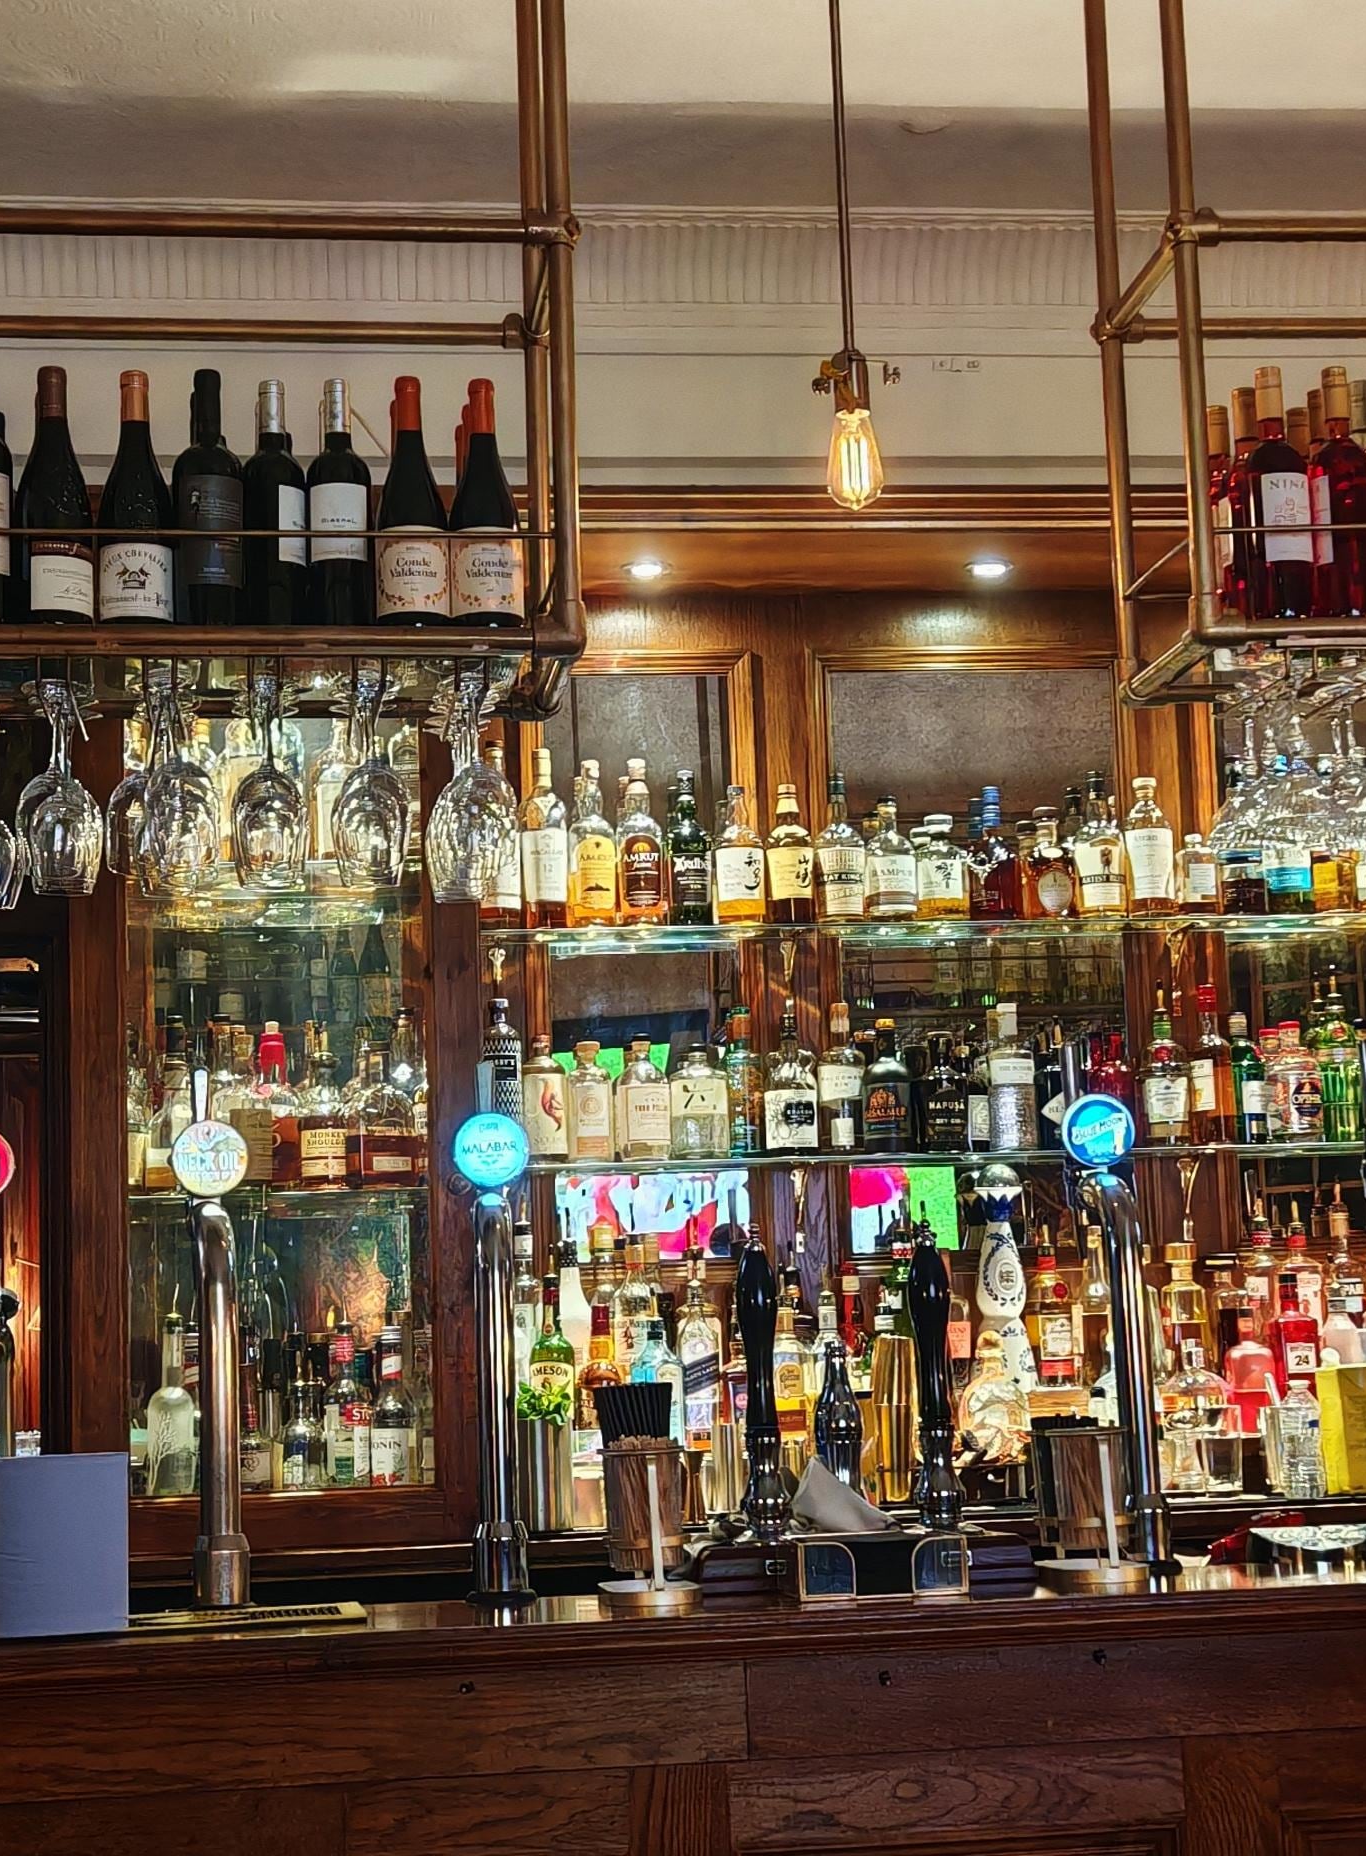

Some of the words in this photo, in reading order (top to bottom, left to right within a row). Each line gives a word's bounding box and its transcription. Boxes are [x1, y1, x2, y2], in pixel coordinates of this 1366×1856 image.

[1074, 1124, 1099, 1143] BLUE
[1099, 1117, 1124, 1133] MOON
[461, 1141, 518, 1154] MALABAR
[176, 1152, 216, 1173] NECK
[219, 1151, 241, 1173] OIL
[1294, 1354, 1310, 1366] 24
[373, 1440, 403, 1450] ONIN
